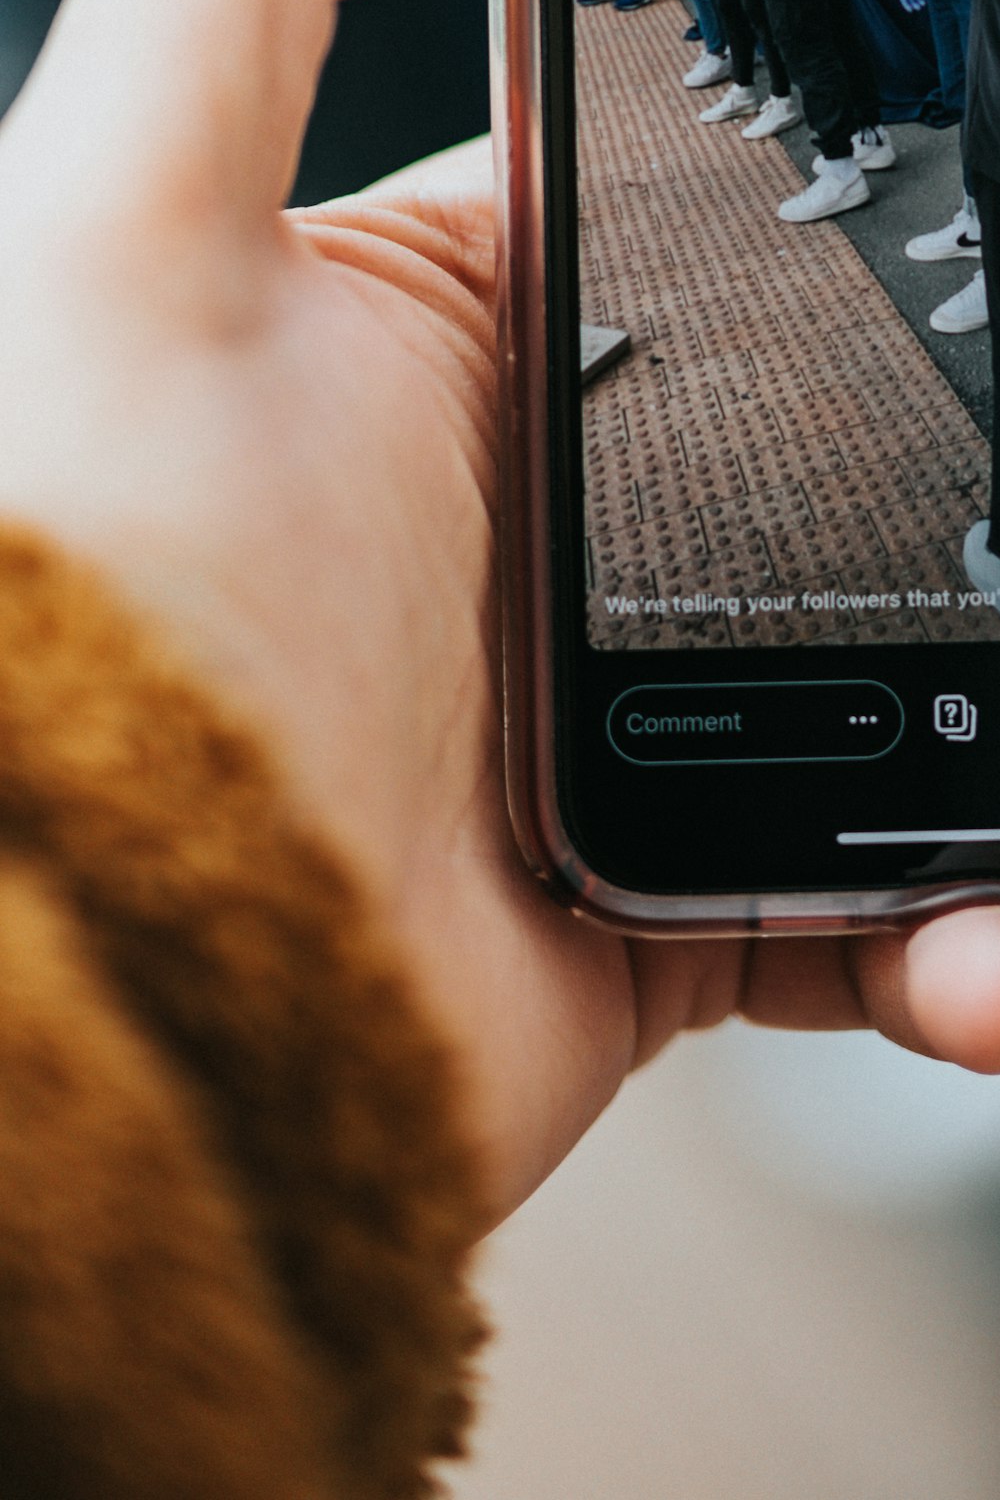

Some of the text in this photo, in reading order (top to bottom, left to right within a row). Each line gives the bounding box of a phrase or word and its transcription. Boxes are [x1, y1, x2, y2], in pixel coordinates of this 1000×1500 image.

[605, 595, 667, 614] We're
[673, 593, 740, 617] telling
[747, 594, 796, 615] your
[801, 590, 901, 611] followers
[907, 588, 950, 607] that
[626, 711, 742, 734] Comment
